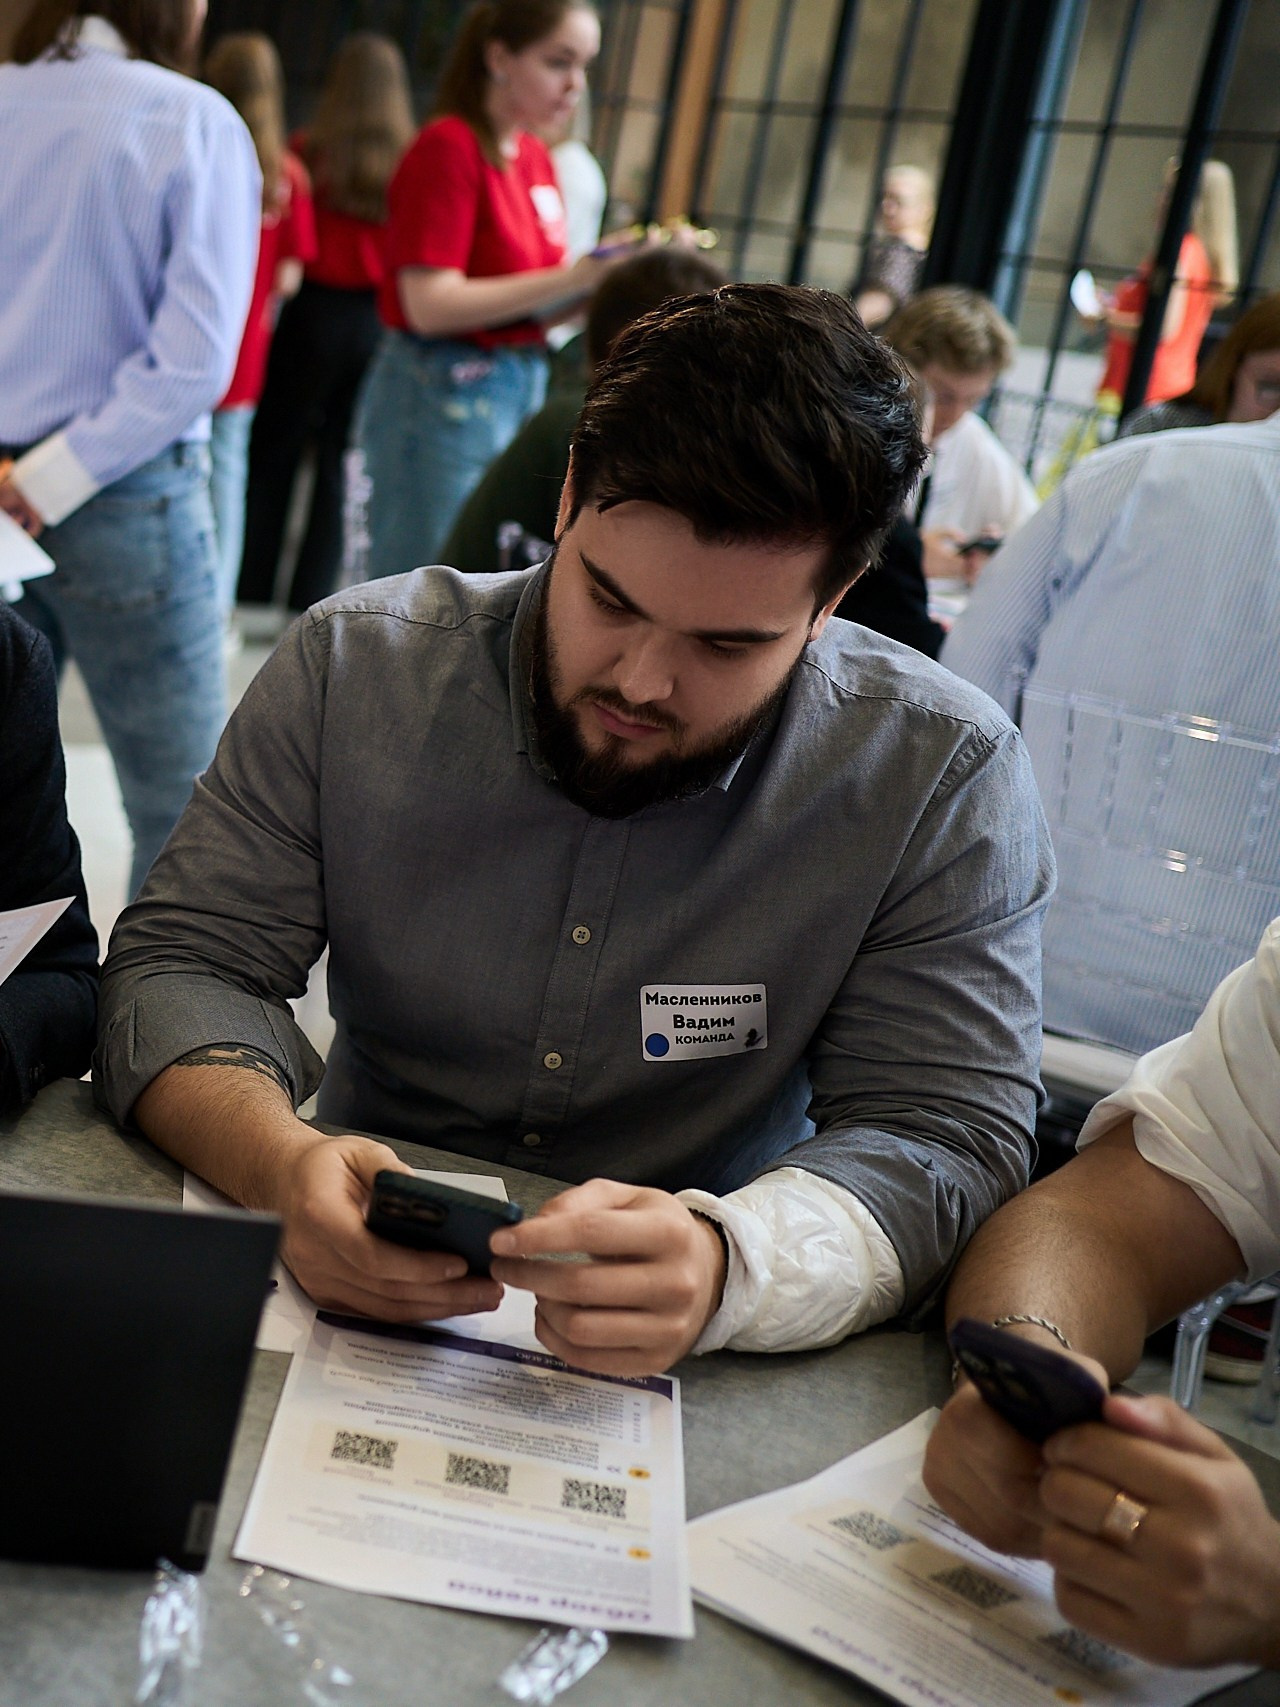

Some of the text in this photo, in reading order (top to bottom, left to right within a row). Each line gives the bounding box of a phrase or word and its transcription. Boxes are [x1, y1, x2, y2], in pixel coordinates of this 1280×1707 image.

[645, 992, 762, 1006] Масленников
[672, 1014, 735, 1030] Вадим
[675, 1033, 735, 1045] КОМАНДА
